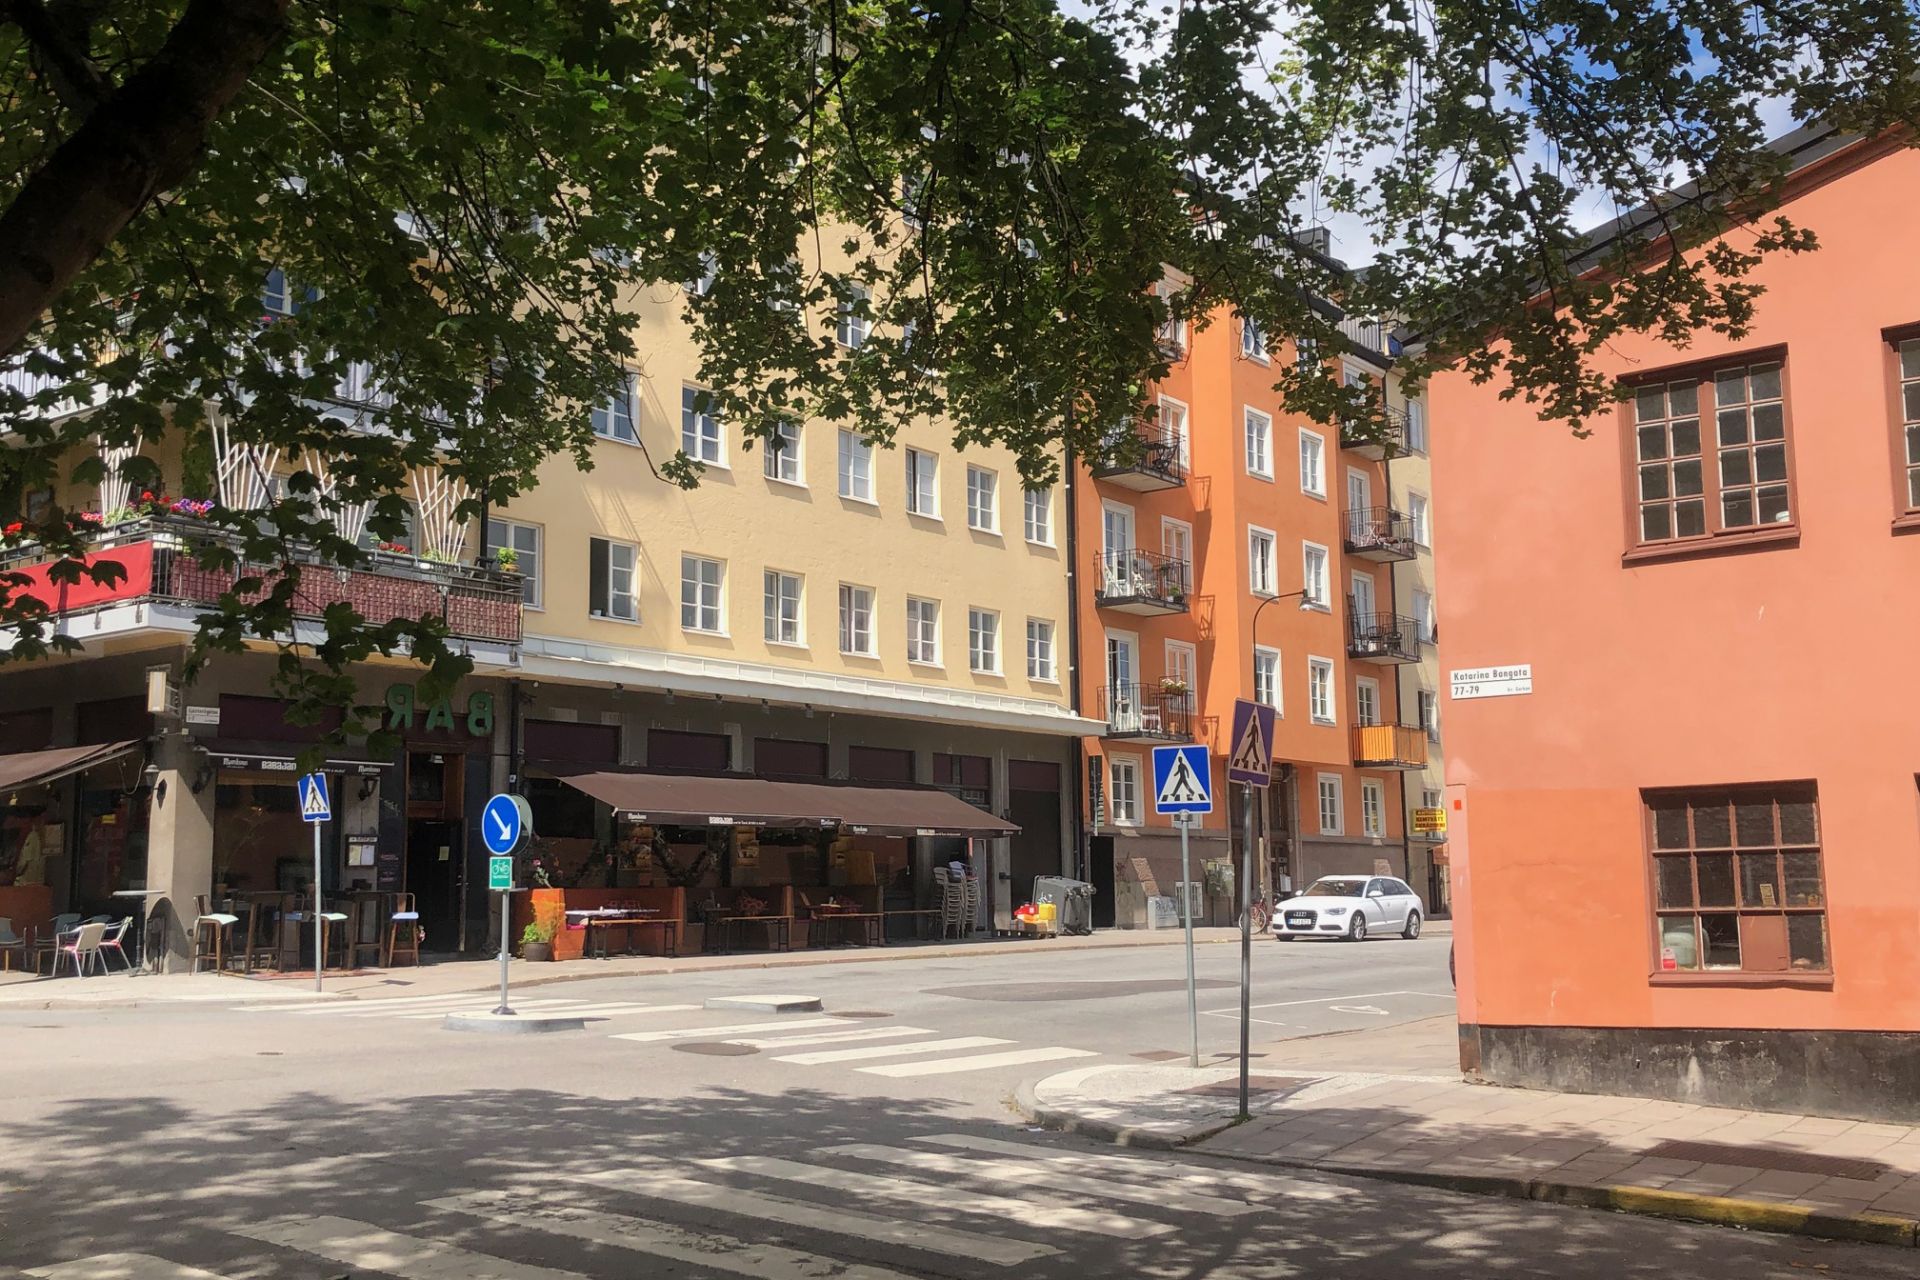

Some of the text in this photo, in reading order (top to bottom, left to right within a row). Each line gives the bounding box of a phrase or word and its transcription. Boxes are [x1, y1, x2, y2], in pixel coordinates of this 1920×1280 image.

[1453, 669, 1528, 681] Katarina Bangata
[1454, 686, 1480, 695] 77-79
